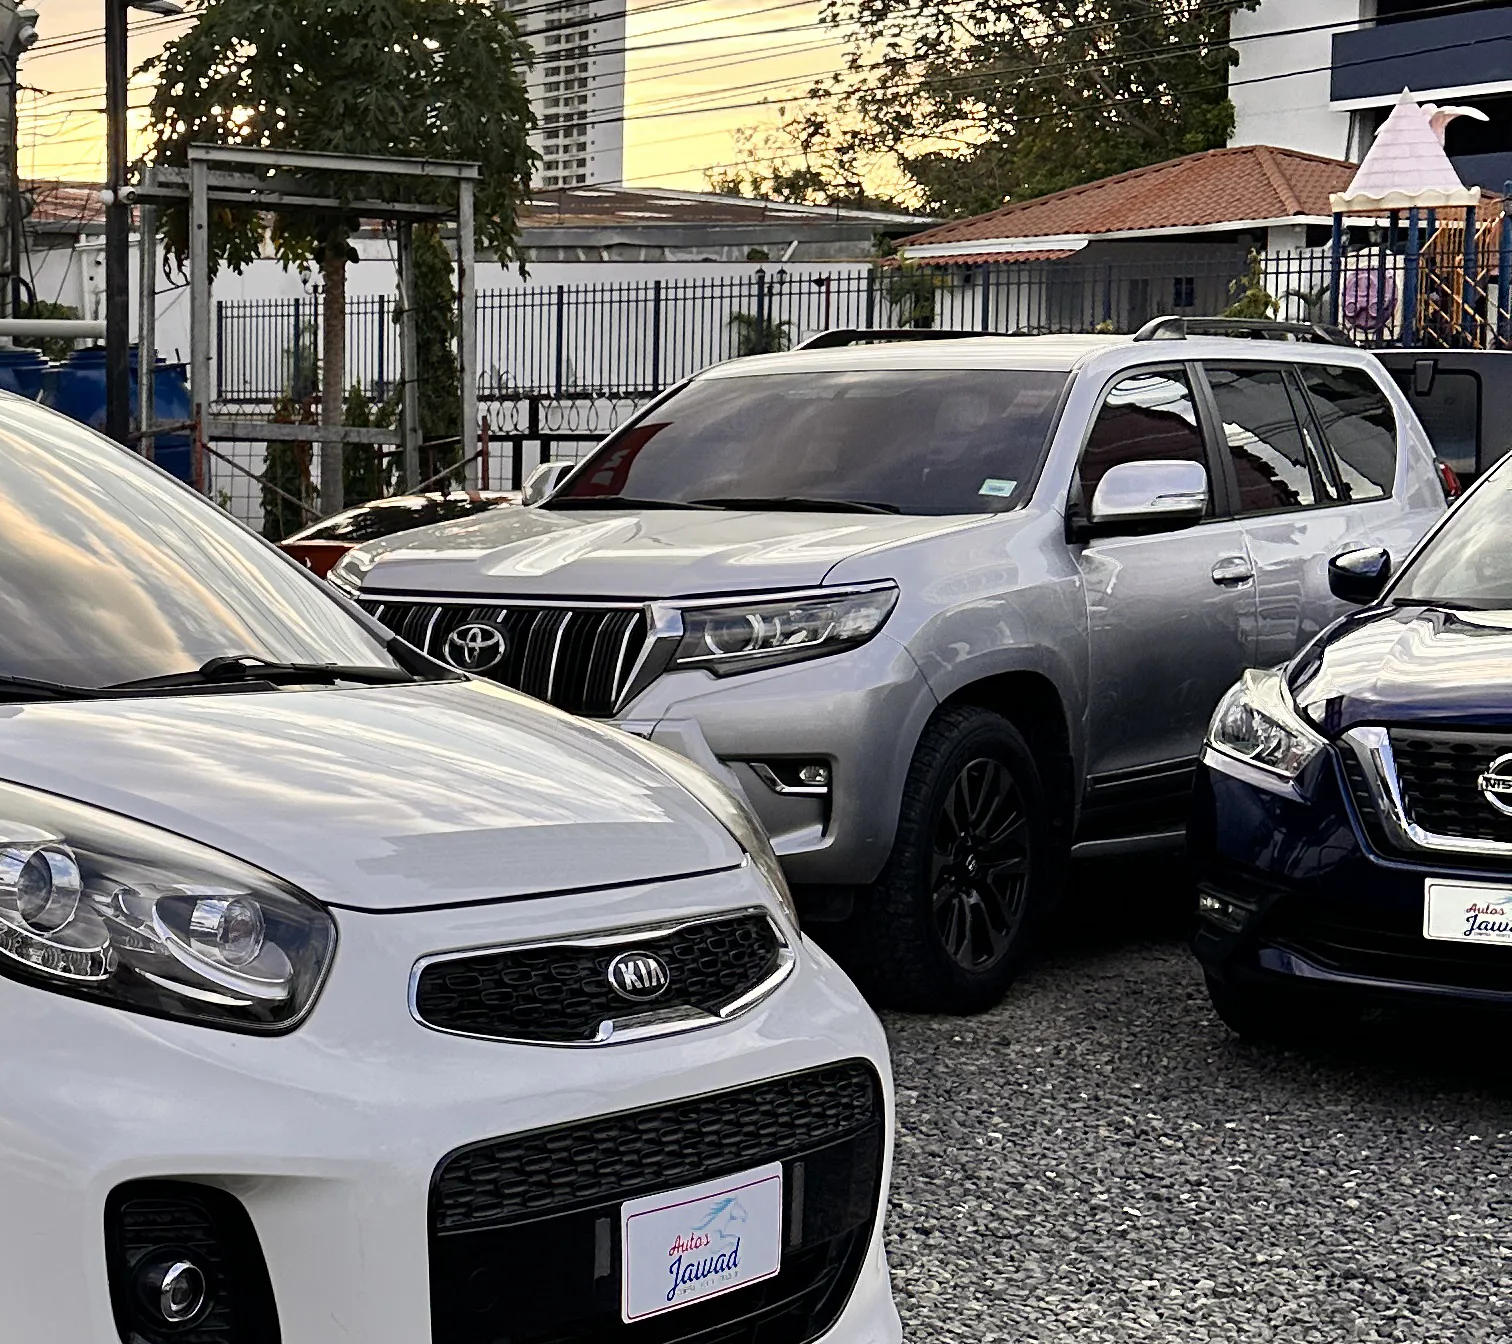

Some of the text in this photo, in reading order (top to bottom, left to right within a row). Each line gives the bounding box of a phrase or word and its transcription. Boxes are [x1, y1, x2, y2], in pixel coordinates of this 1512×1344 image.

[1463, 913, 1512, 937] Jaw
[617, 958, 666, 991] KIA
[668, 1232, 711, 1257] Autos
[666, 1236, 741, 1302] Jawad
